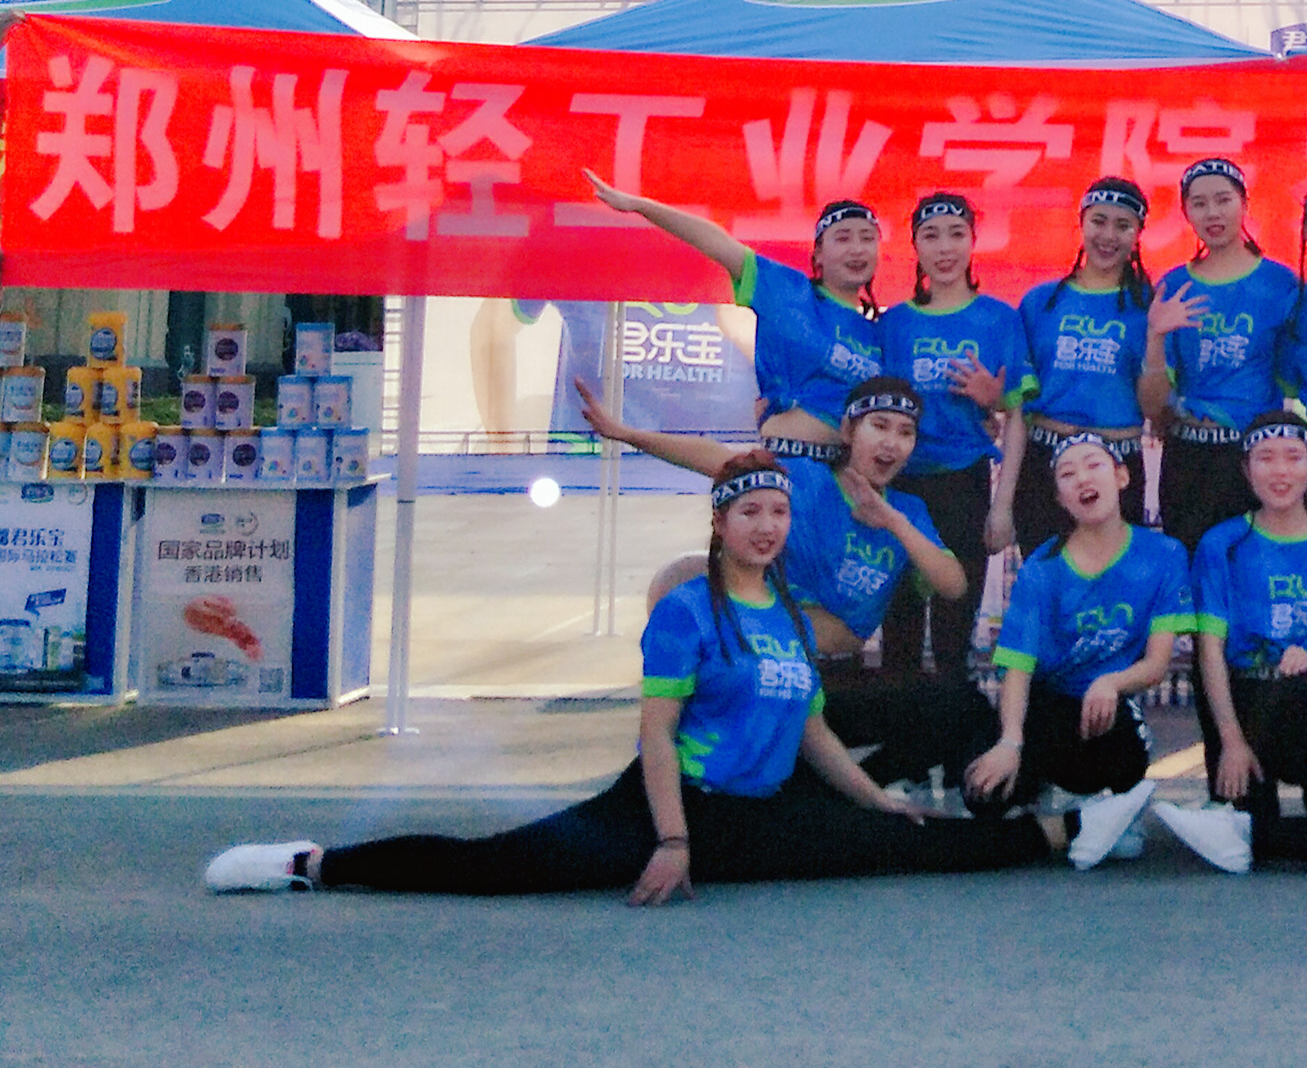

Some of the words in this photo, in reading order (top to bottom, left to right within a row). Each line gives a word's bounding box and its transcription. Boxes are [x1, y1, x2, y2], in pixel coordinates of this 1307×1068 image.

[647, 365, 724, 383] HEALTH
[158, 539, 290, 560] 国家品牌计划
